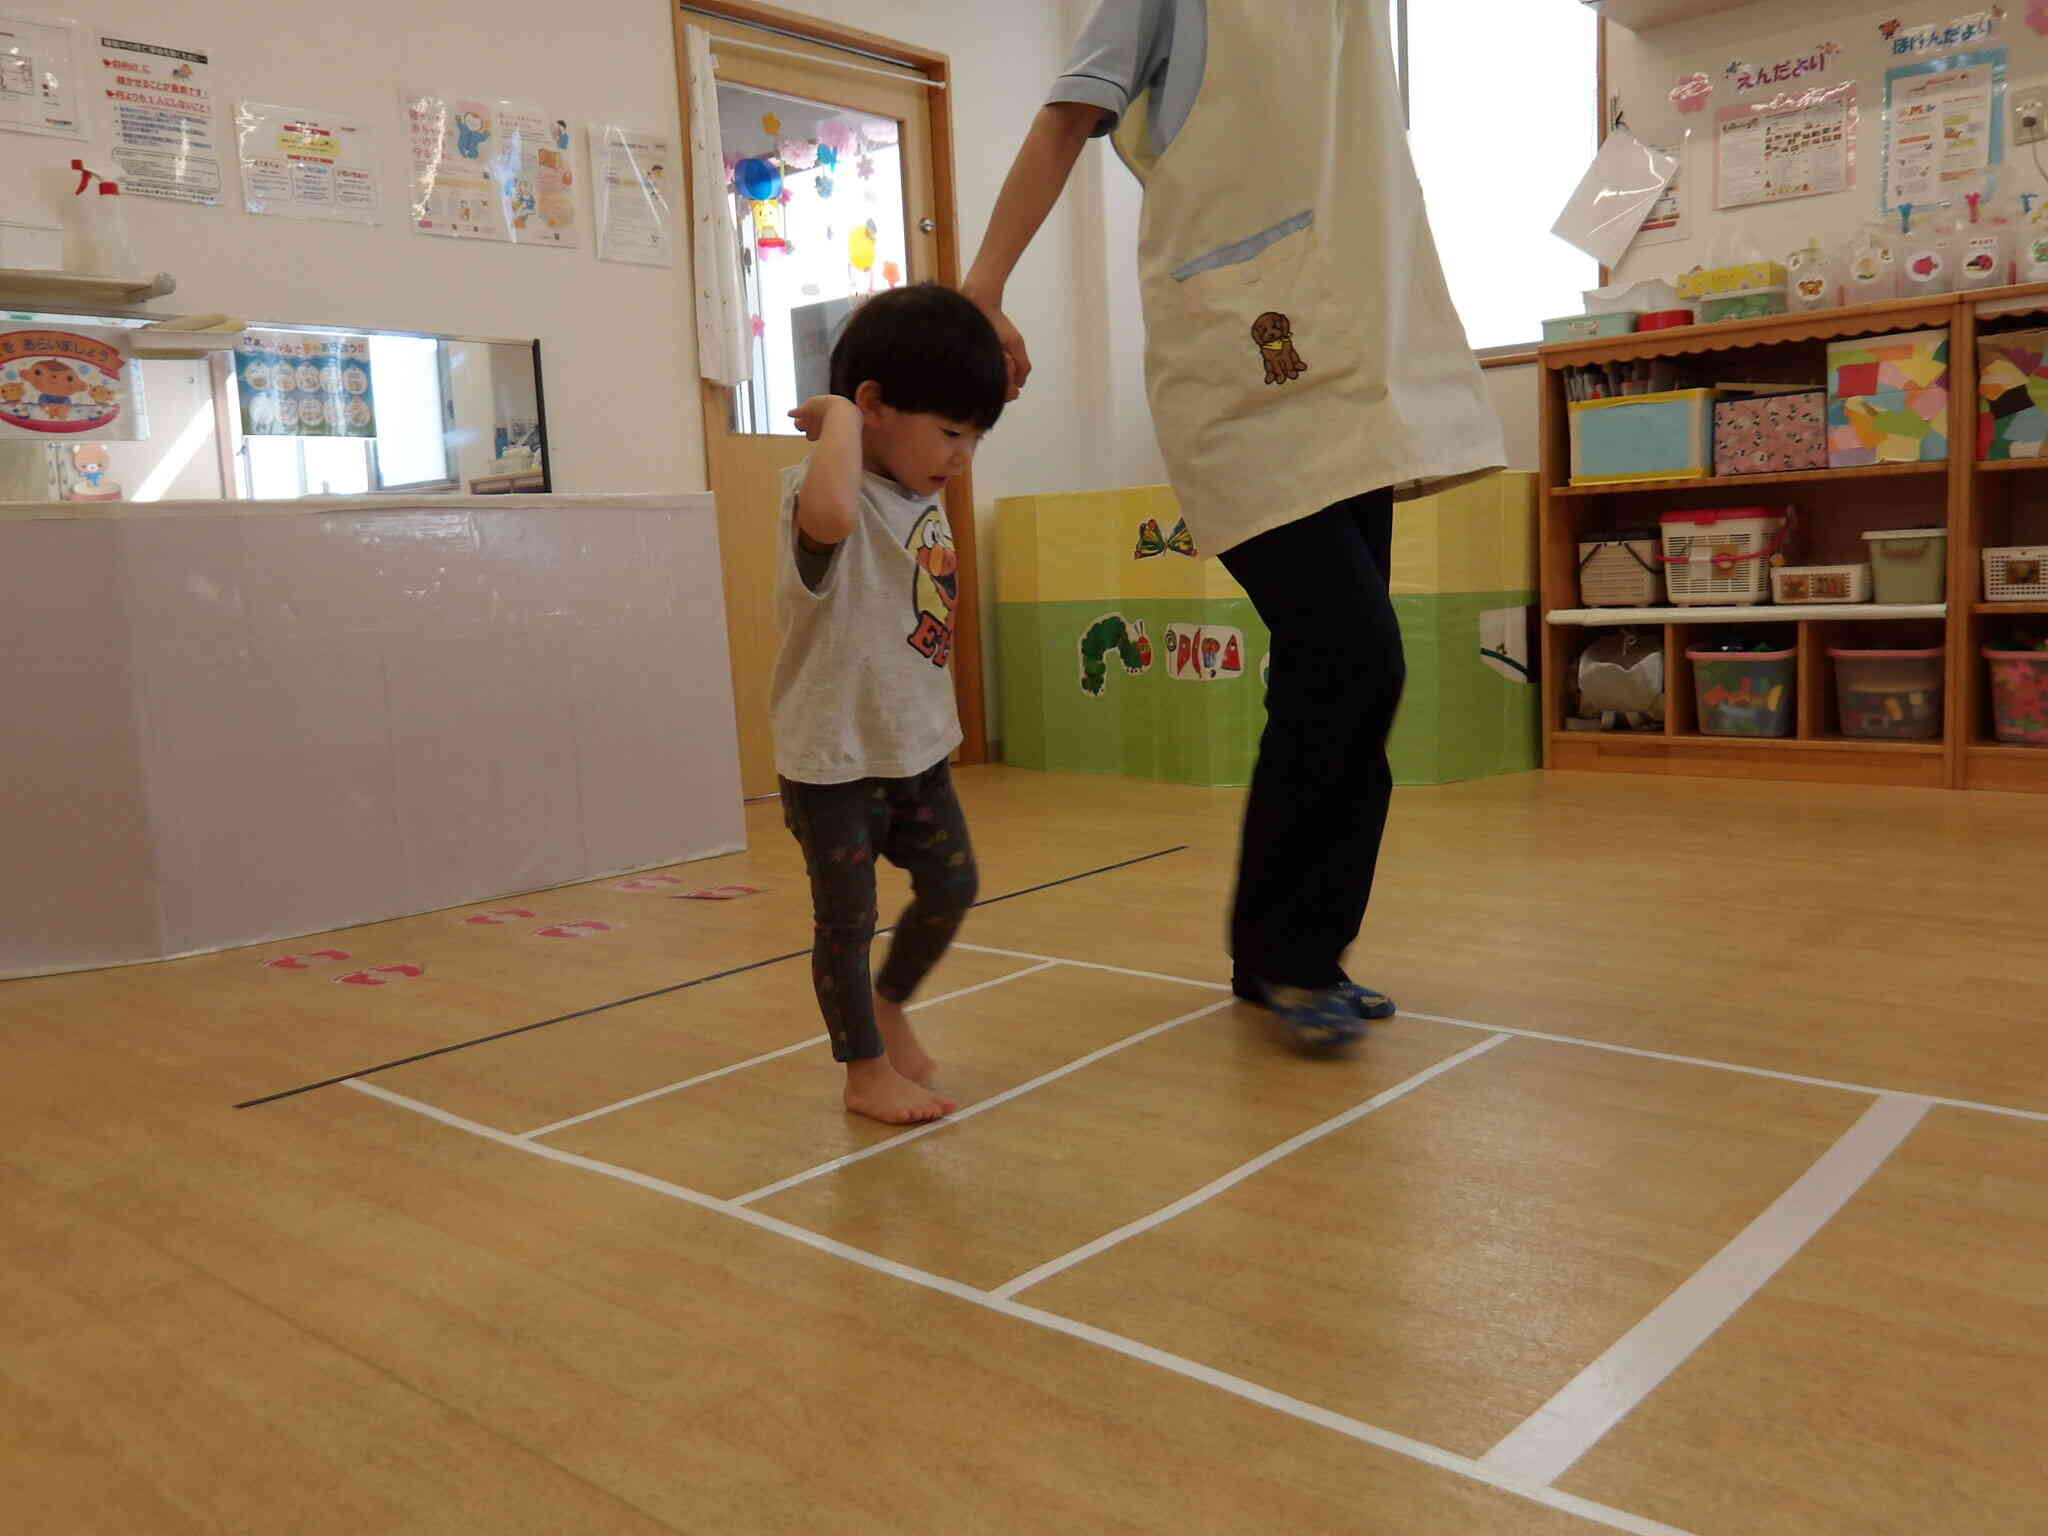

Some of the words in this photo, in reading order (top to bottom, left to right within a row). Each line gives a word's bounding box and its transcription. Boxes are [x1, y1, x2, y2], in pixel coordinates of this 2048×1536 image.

[1736, 51, 1825, 90] えんだより
